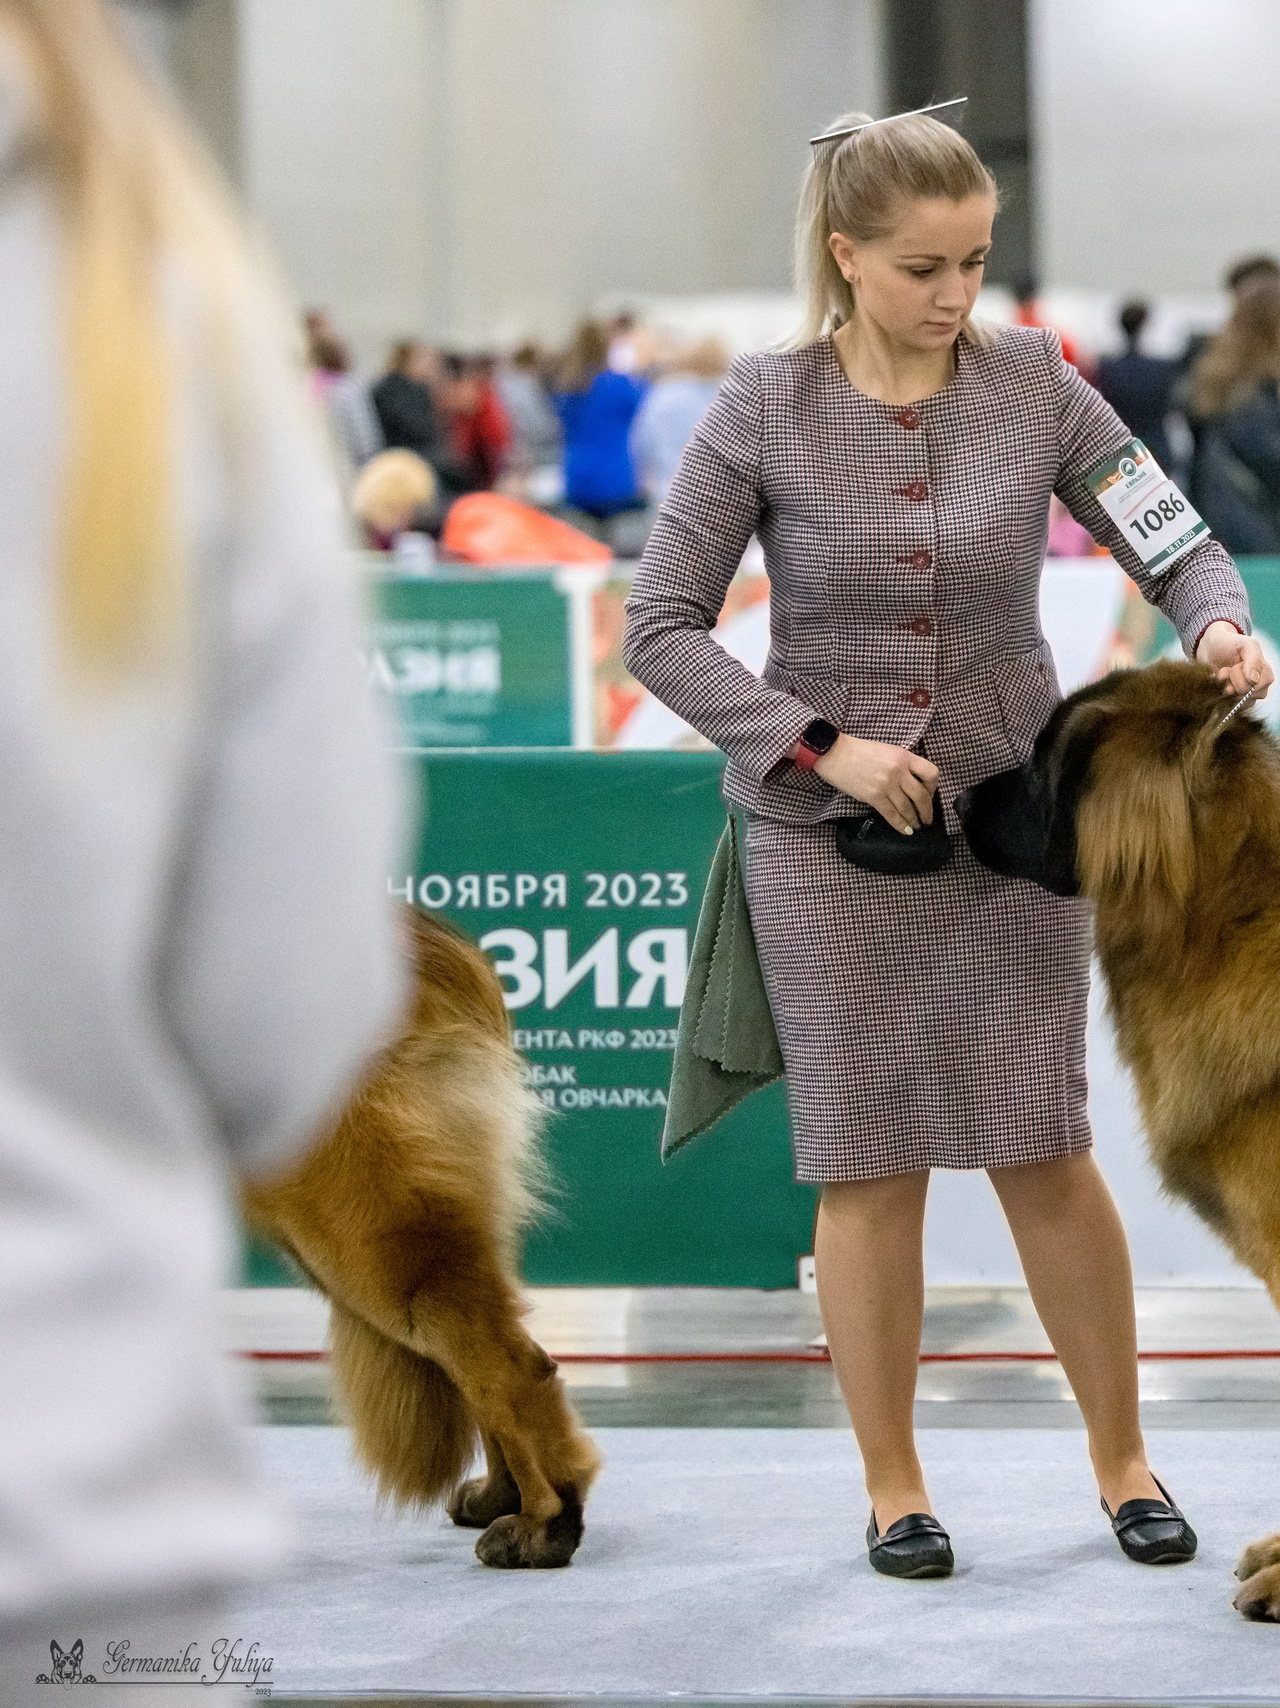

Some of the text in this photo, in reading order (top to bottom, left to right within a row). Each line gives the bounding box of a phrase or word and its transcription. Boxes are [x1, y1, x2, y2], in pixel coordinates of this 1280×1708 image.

[1129, 493, 1185, 540] 1086
[1166, 530, 1196, 555] 18.11.2023
[585, 872, 689, 908] 2023
[480, 926, 689, 1011] ЗИЯ
[513, 1029, 575, 1049] ЕНТА
[578, 1029, 627, 1049] РКФ
